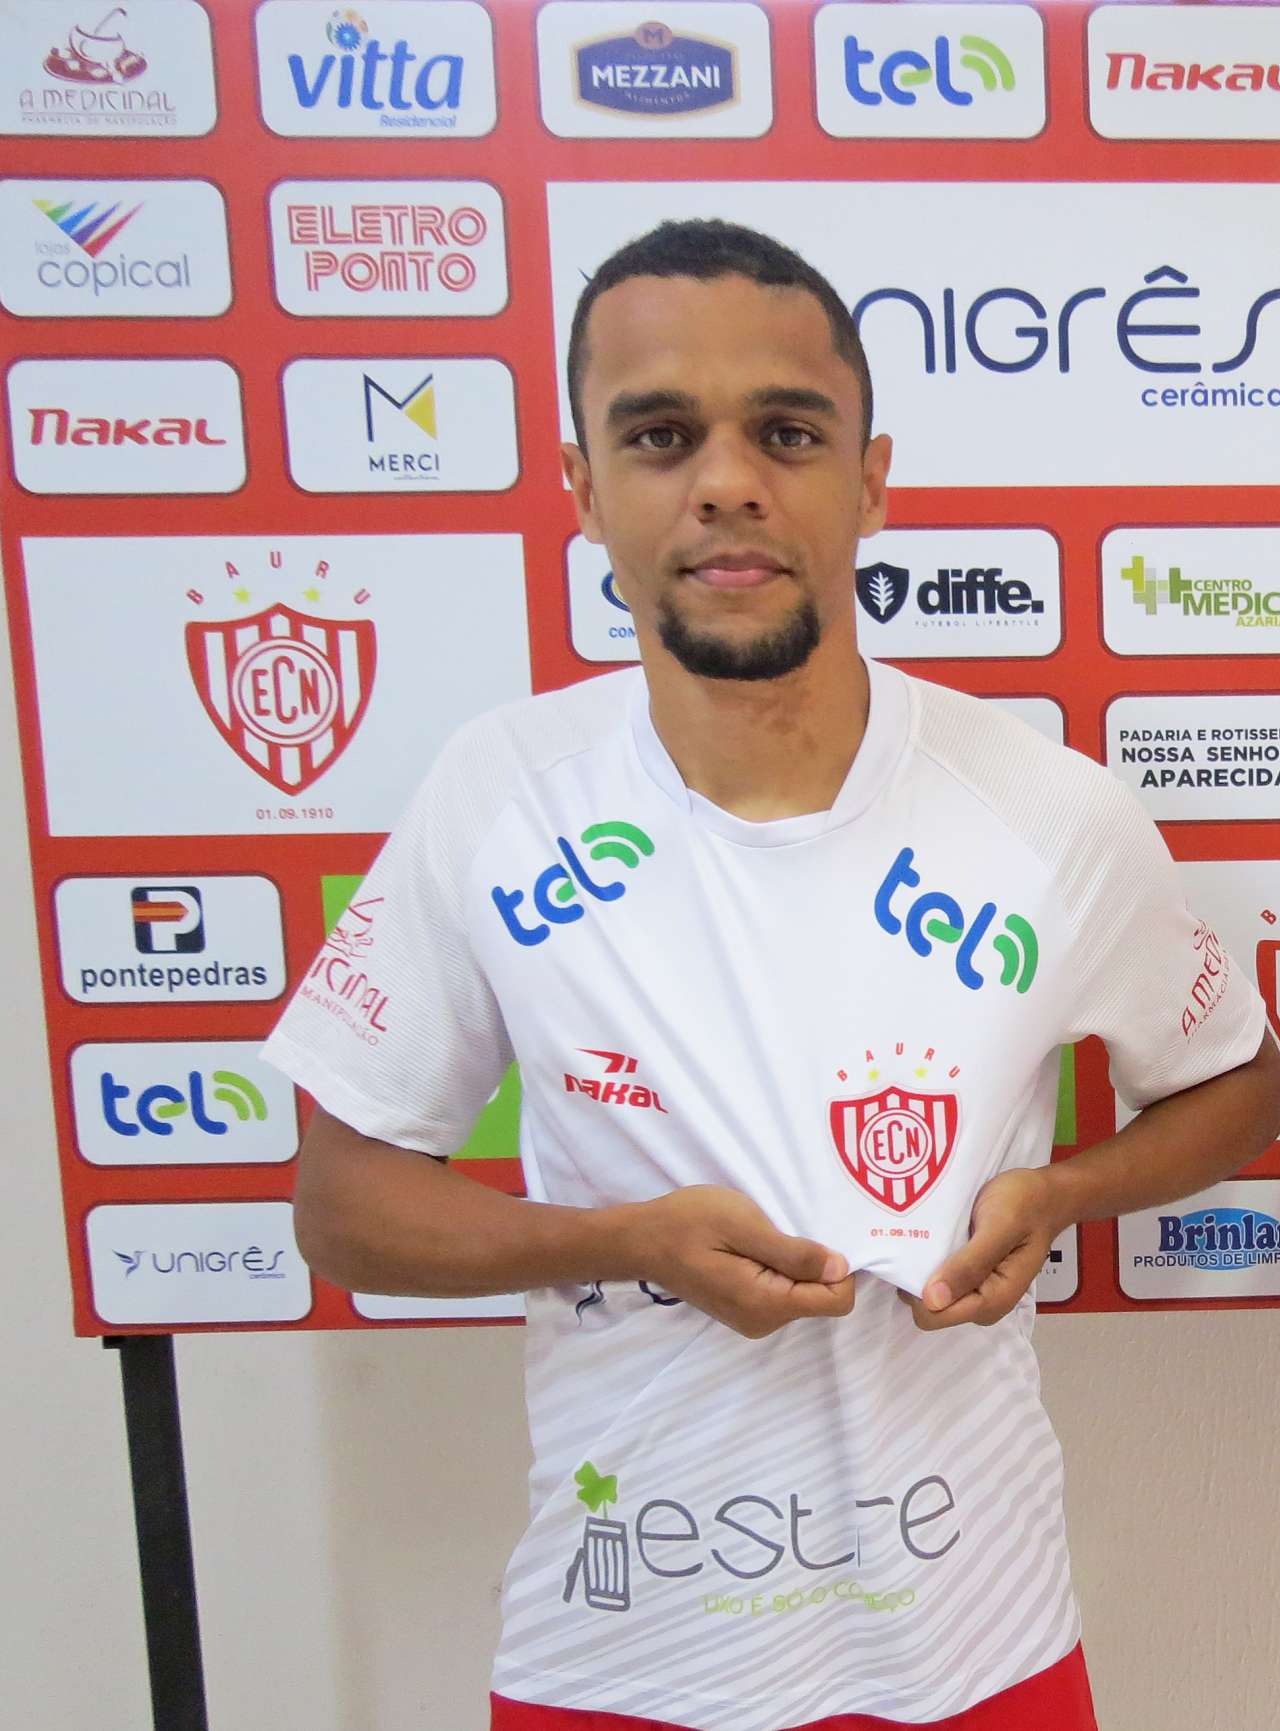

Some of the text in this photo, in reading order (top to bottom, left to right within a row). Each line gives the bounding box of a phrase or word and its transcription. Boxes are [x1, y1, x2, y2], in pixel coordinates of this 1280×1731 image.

[288, 38, 464, 112] vitta
[591, 64, 721, 89] MEZZANI
[43, 88, 177, 111] MEDICINAL
[286, 203, 488, 246] ELETRO
[38, 253, 190, 296] copical
[368, 453, 440, 472] MERCI
[1193, 579, 1253, 593] CENTRO
[251, 654, 321, 725] ECN
[1119, 729, 1193, 743] PADARIA
[1197, 729, 1208, 742] E
[1121, 746, 1196, 764] NOSSA
[255, 807, 335, 821] 01.09.1910
[80, 960, 269, 994] pontepedras
[872, 1119, 921, 1165] ECN
[870, 1227, 931, 1240] 01.09.1910
[1133, 1252, 1219, 1268] PRODUTOS
[1222, 1251, 1244, 1266] DE
